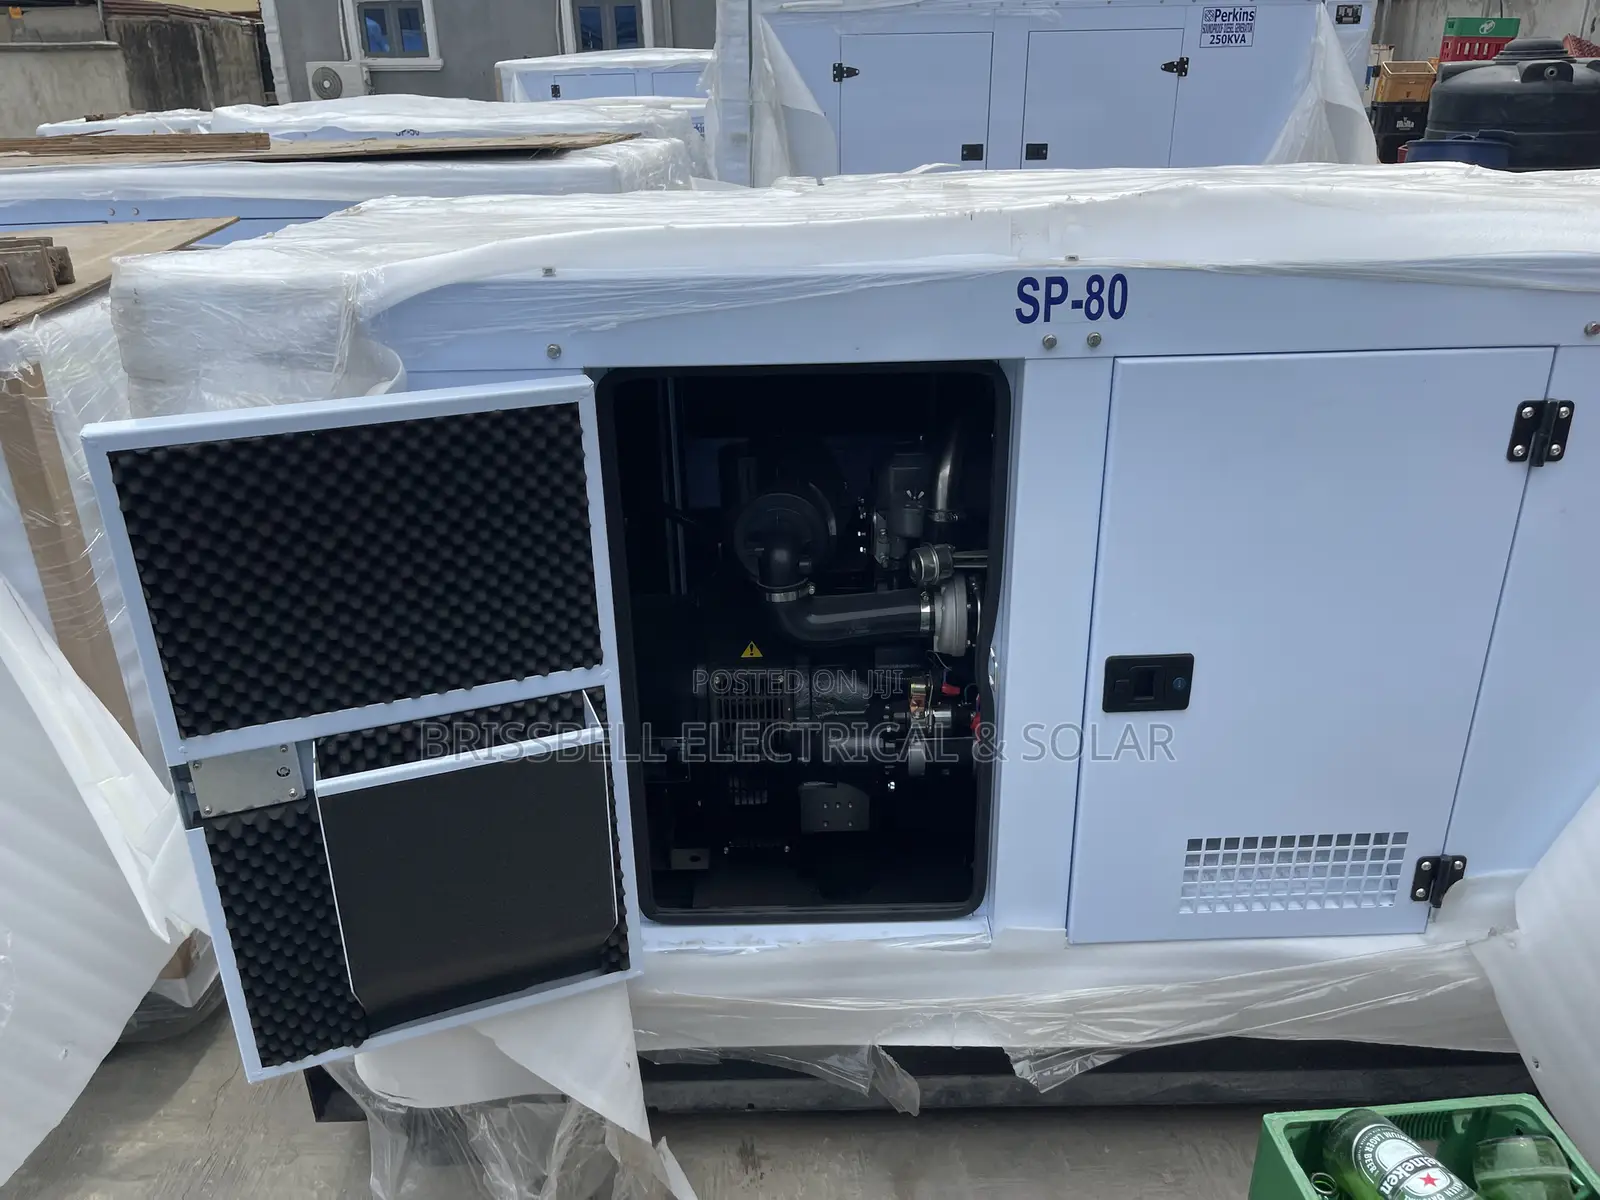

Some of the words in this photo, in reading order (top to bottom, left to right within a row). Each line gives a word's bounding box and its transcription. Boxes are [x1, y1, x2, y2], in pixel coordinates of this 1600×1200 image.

[1214, 8, 1255, 22] Perkins
[1209, 34, 1246, 44] 250KVA
[1015, 273, 1128, 324] SP-80
[1363, 1133, 1385, 1153] LAGER
[1363, 1153, 1378, 1174] BEER
[1380, 1156, 1436, 1195] eineken
